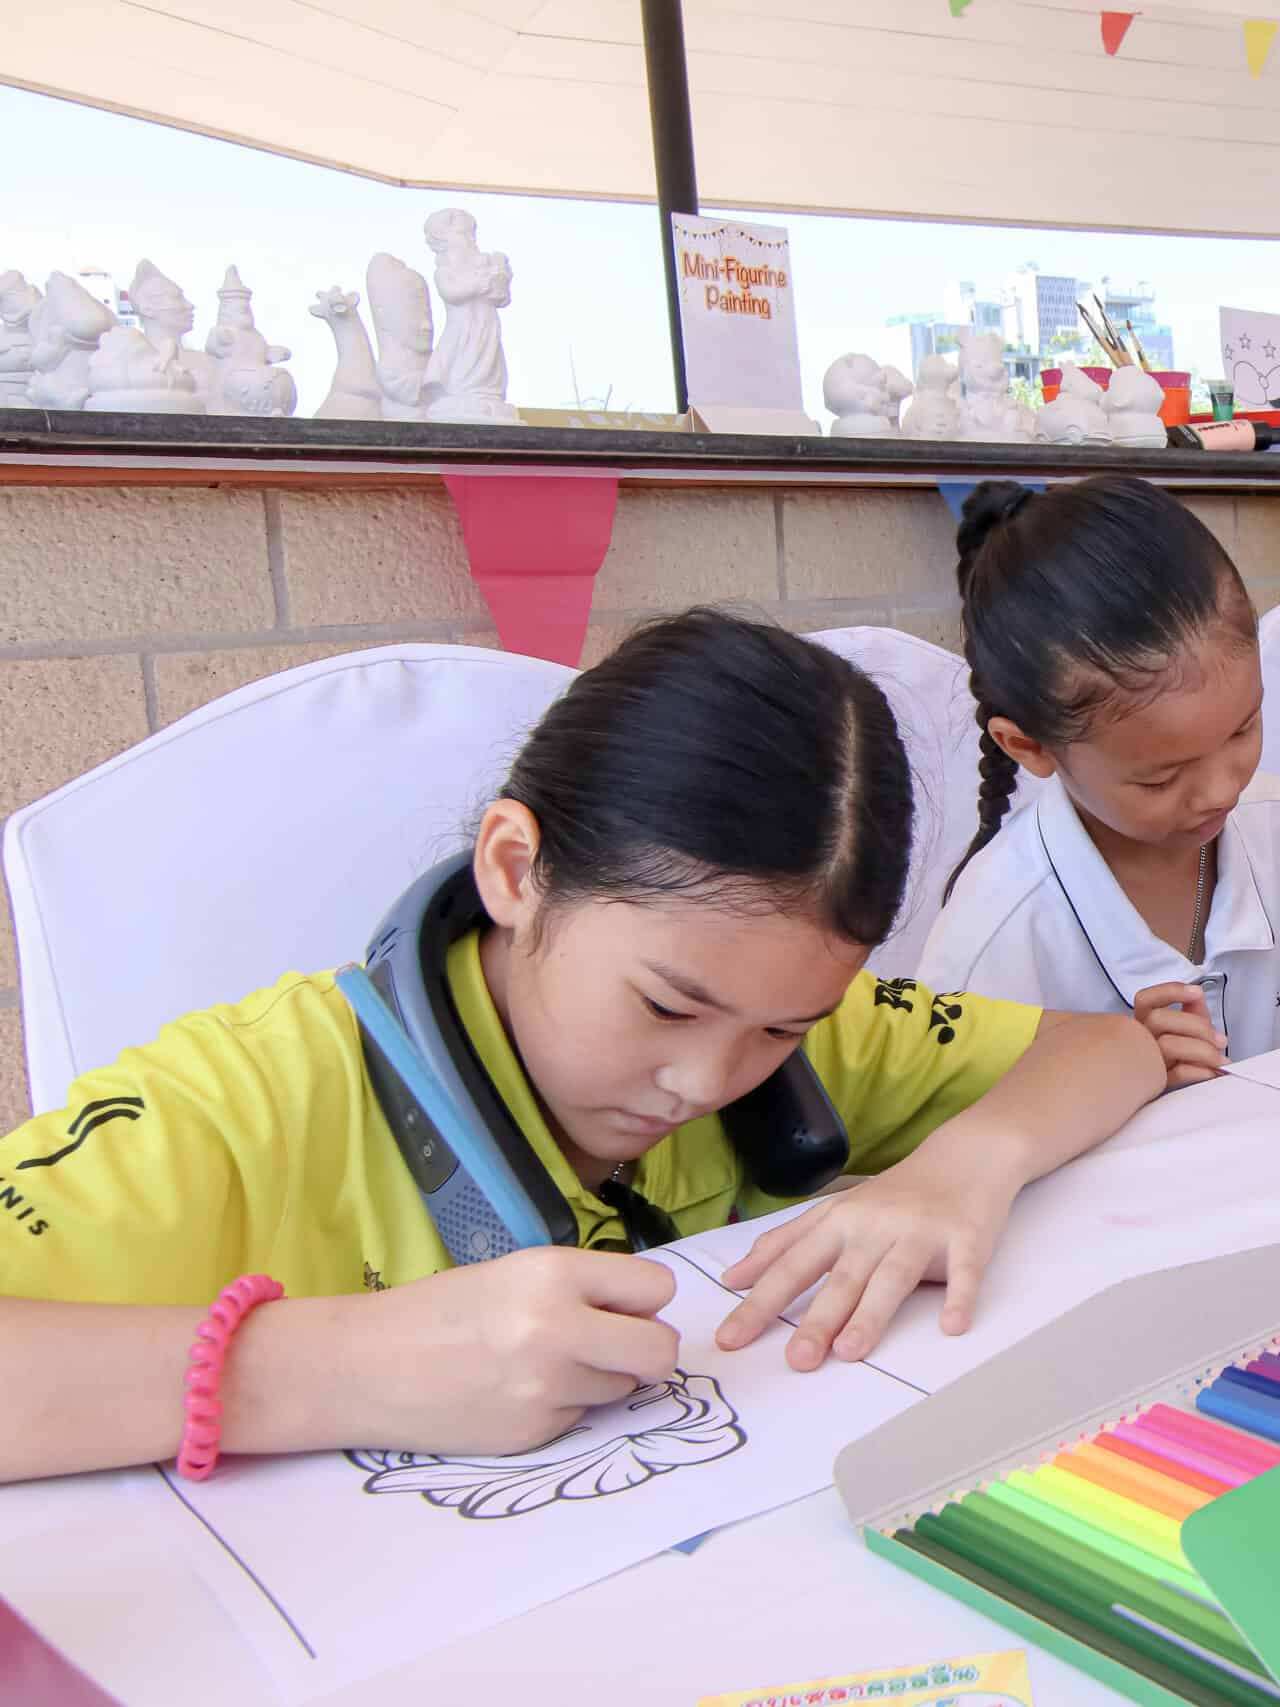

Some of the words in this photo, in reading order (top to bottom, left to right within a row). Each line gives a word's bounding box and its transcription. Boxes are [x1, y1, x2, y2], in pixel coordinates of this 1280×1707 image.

[681, 252, 788, 289] Mini-Figurine
[705, 285, 772, 319] Painting
[0, 1176, 49, 1236] NIS
